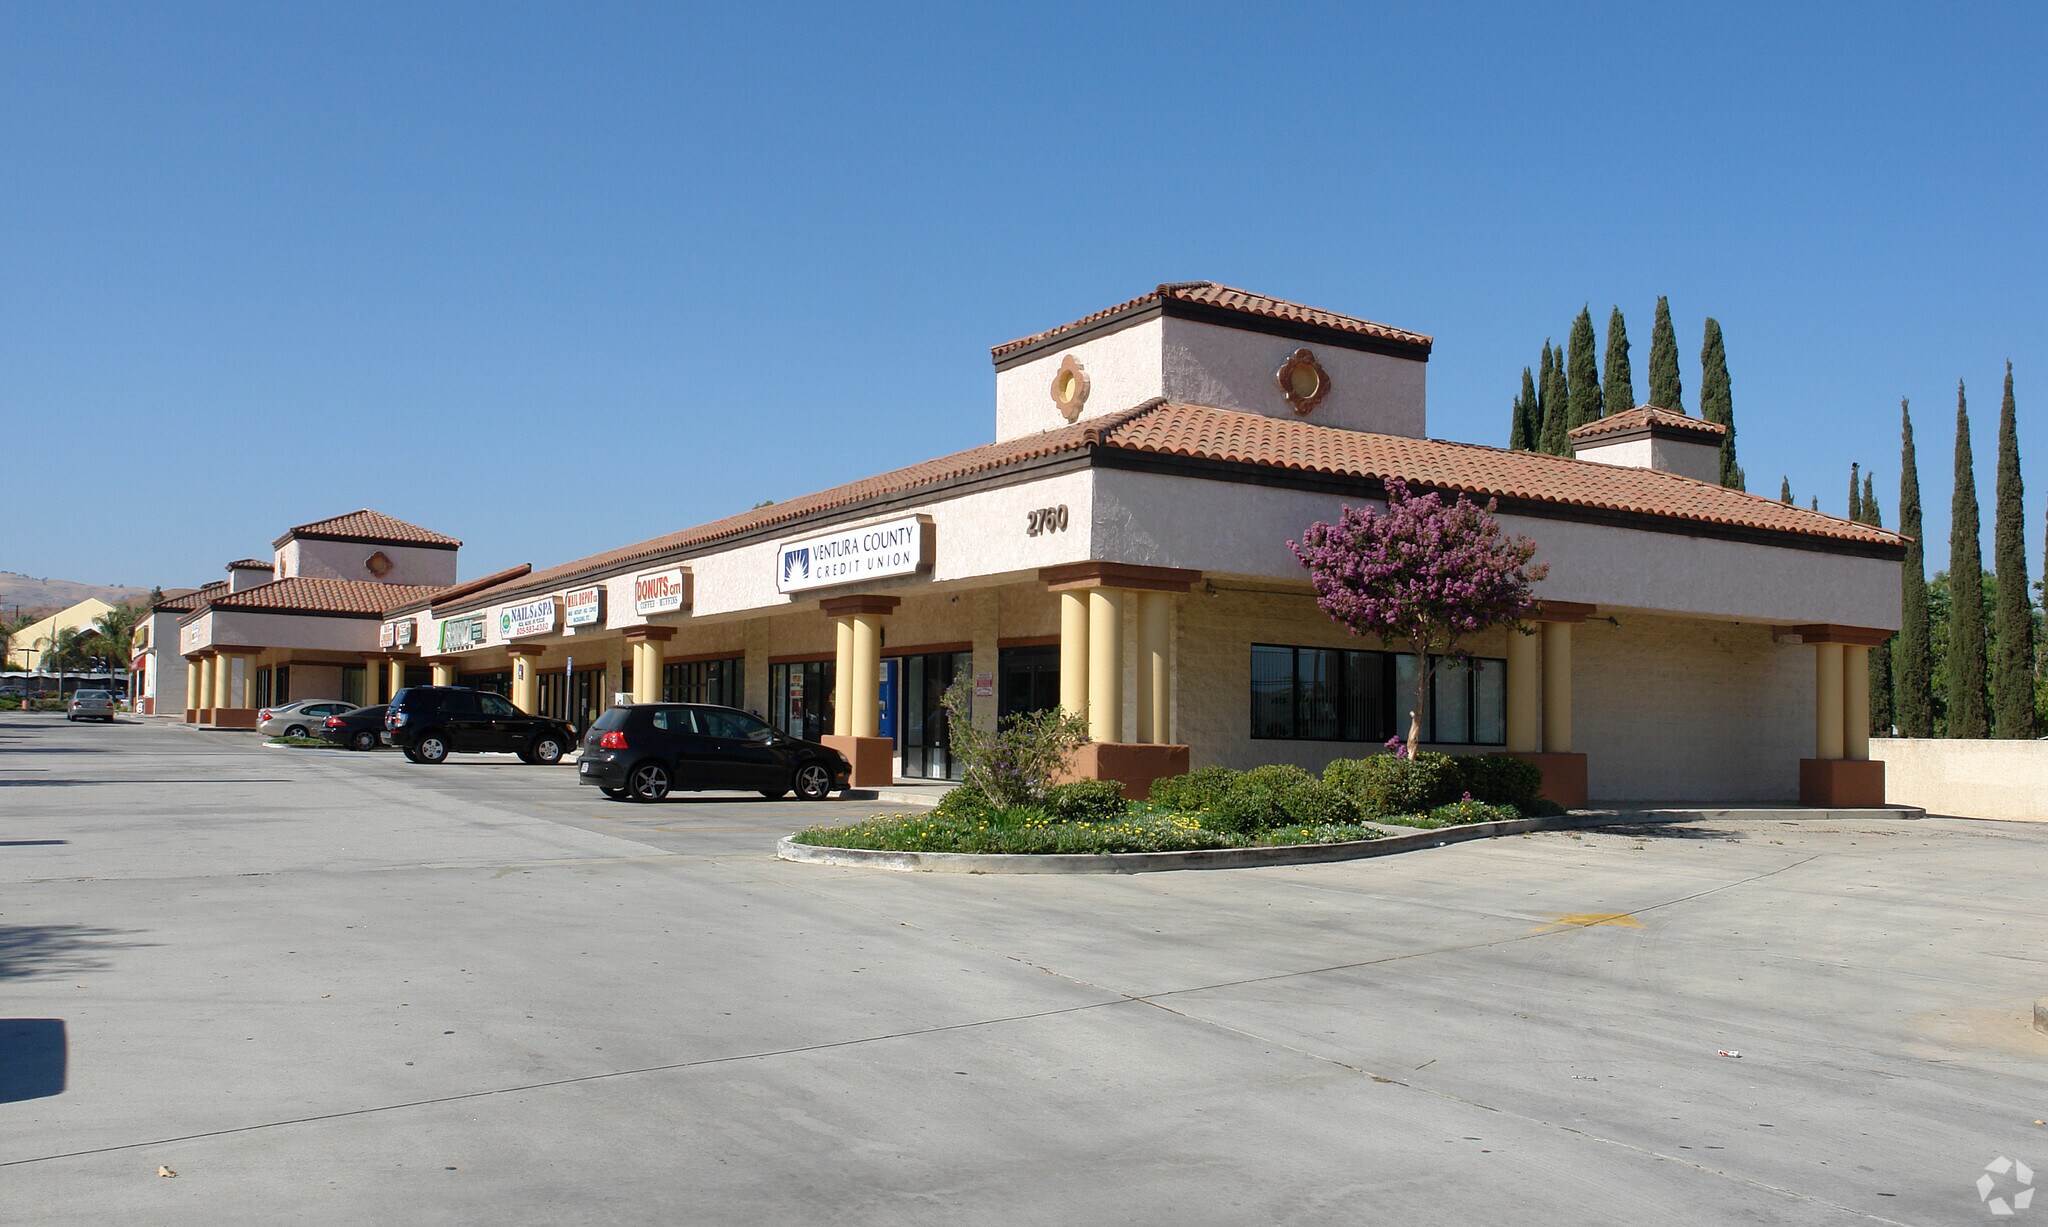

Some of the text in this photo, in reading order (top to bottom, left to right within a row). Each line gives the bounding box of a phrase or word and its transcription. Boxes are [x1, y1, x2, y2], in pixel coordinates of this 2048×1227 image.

[1026, 504, 1069, 537] 2760
[813, 526, 913, 561] VENTURA COUNTY
[817, 551, 910, 578] CREDIT UNION
[637, 576, 669, 601] DONUTS
[511, 604, 534, 622] NAILS
[537, 601, 552, 616] SPA
